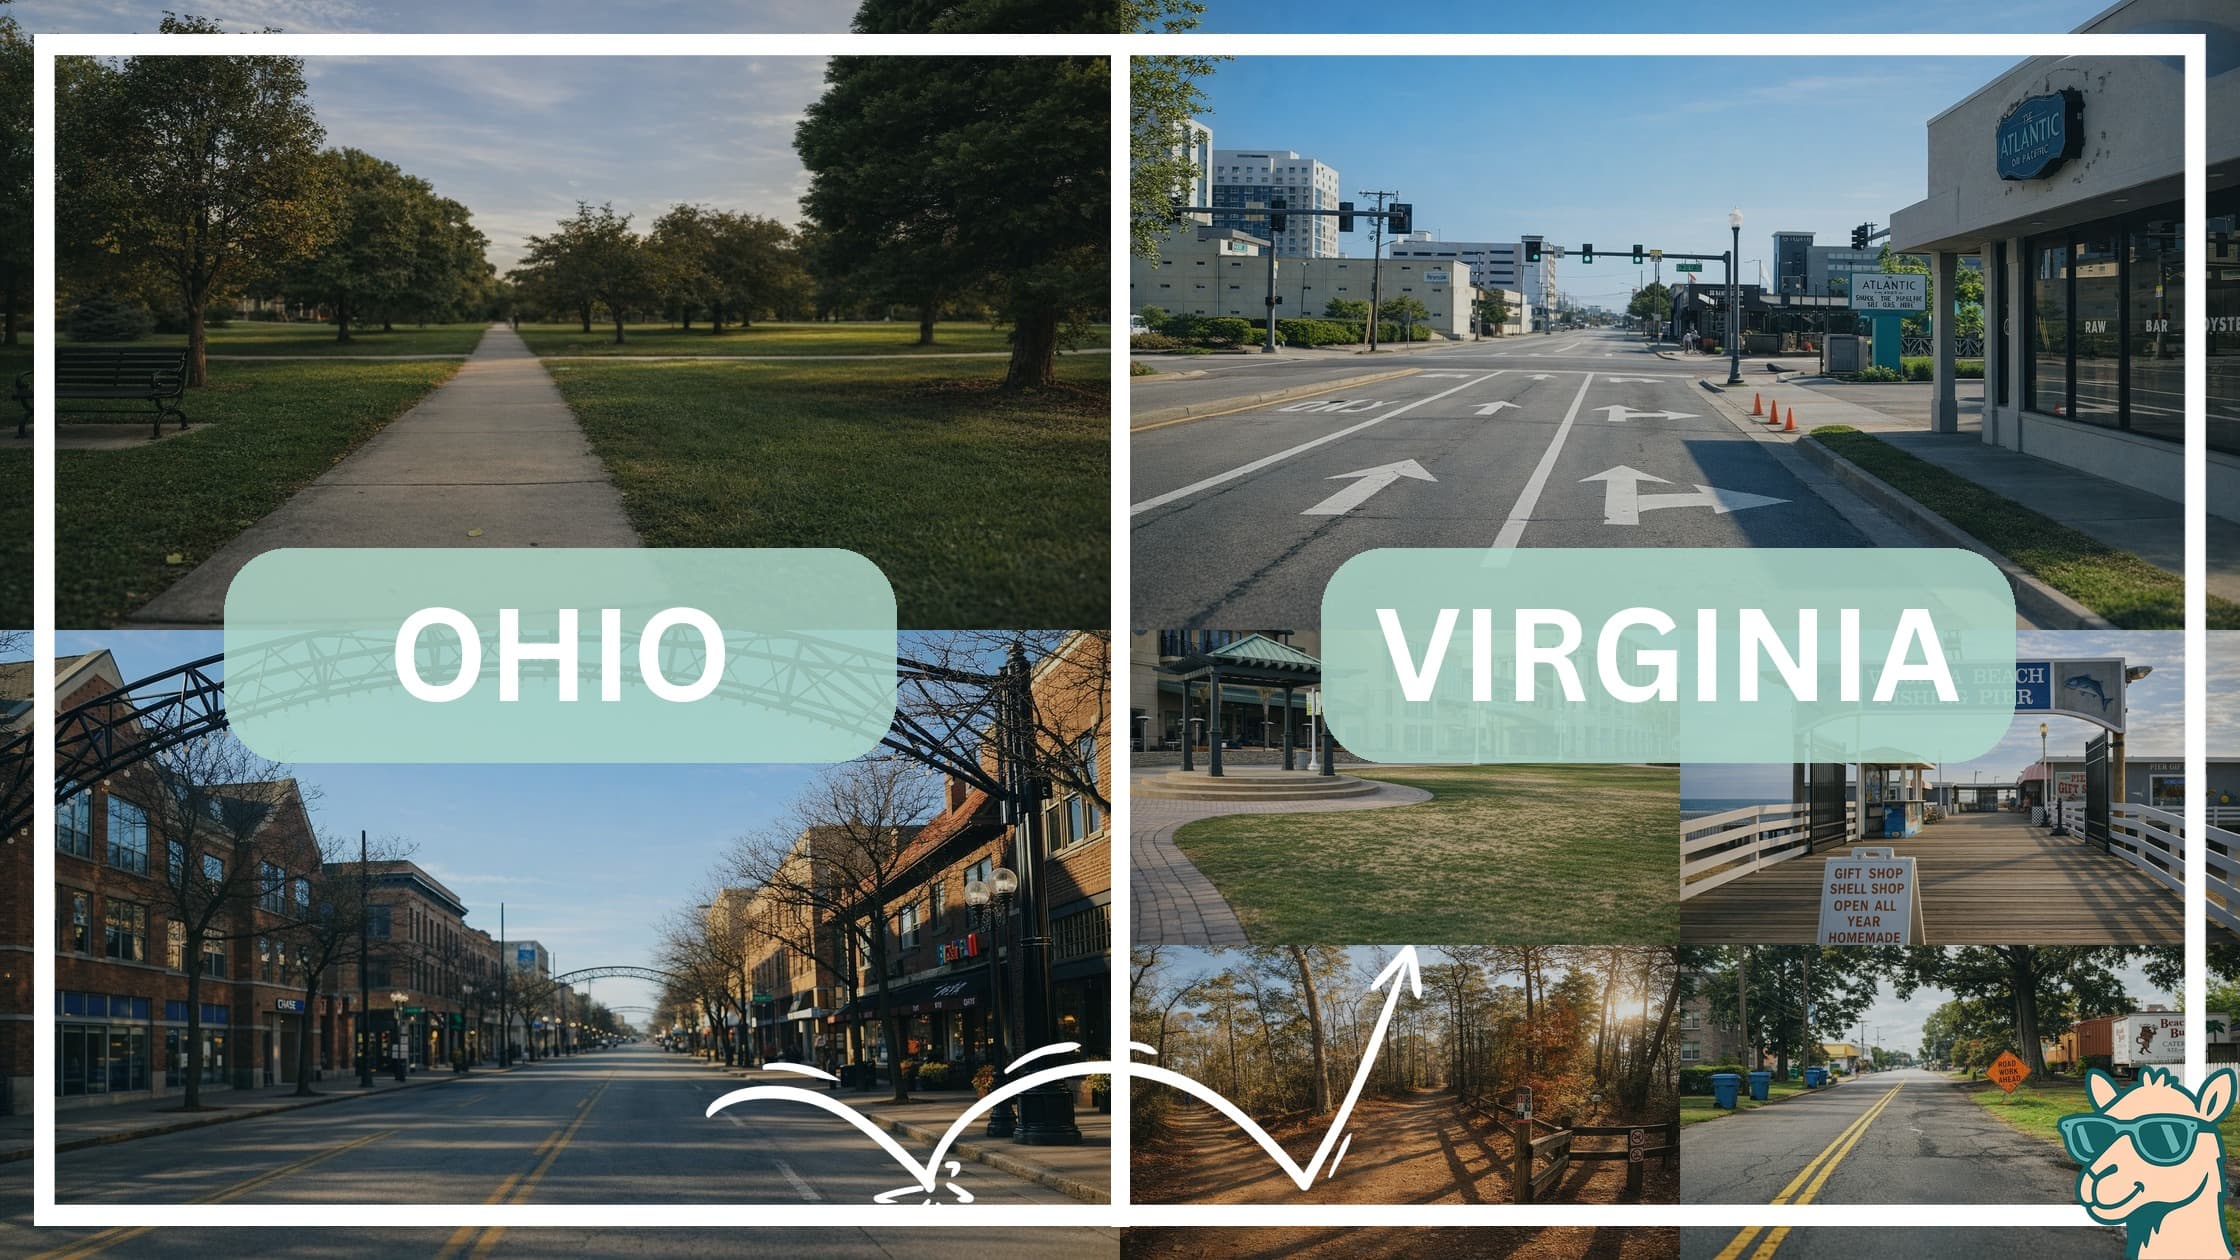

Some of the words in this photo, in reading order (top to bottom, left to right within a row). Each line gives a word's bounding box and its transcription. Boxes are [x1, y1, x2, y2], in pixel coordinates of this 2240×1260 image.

[2000, 112, 2060, 157] ATLANTIC
[1862, 280, 1917, 290] ATLANTIC
[2085, 320, 2107, 334] RAW
[2145, 319, 2168, 333] BAR
[1276, 399, 1401, 413] ONLY
[1973, 668, 2045, 685] BEACH
[1979, 688, 2034, 705] PIER
[2071, 775, 2086, 783] PIE
[2058, 782, 2079, 794] GIFT
[1834, 867, 1862, 880] GIFT
[1868, 867, 1904, 880] SHOP
[1829, 883, 1868, 895] SHELL
[1871, 883, 1905, 895] SHOP
[1833, 900, 1869, 912] OPEN
[1874, 900, 1897, 912] ALL
[1847, 915, 1881, 928] YEAR
[1828, 932, 1902, 944] HOMEMADE
[277, 999, 297, 1010] CHASE
[2160, 1018, 2185, 1029] Beac
[1998, 1060, 2017, 1068] ROAD
[1999, 1068, 2019, 1076] WORK
[1999, 1075, 2021, 1083] AHEAD
